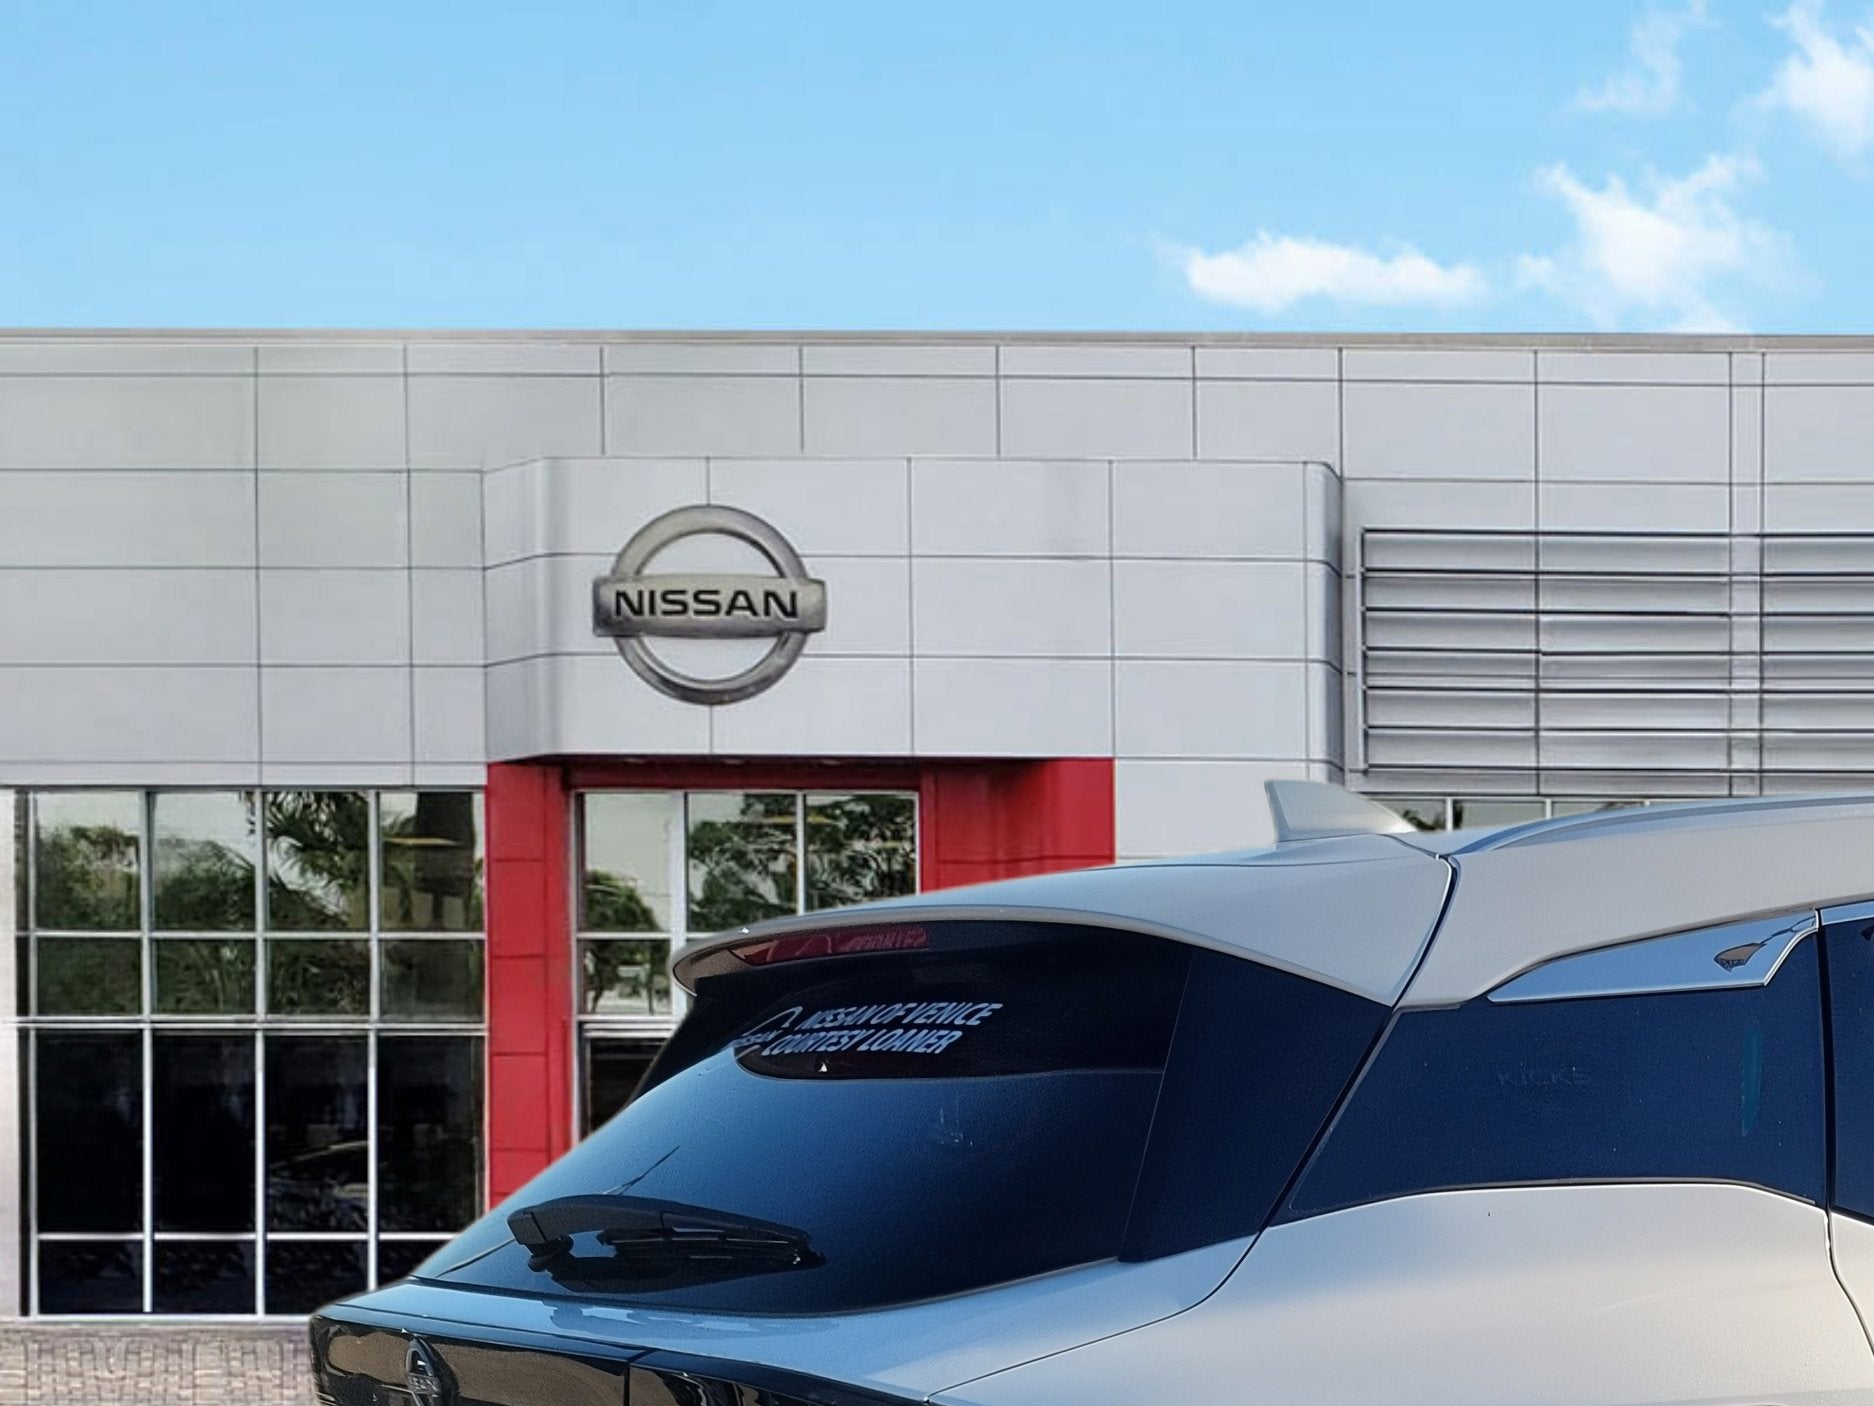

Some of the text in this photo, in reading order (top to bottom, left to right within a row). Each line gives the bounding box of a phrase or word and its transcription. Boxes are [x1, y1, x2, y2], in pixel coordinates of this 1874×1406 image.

[614, 589, 799, 619] NISSAN
[793, 1002, 1003, 1032] NISSAN OF VENICE
[761, 1028, 963, 1056] COURTESY LOANER
